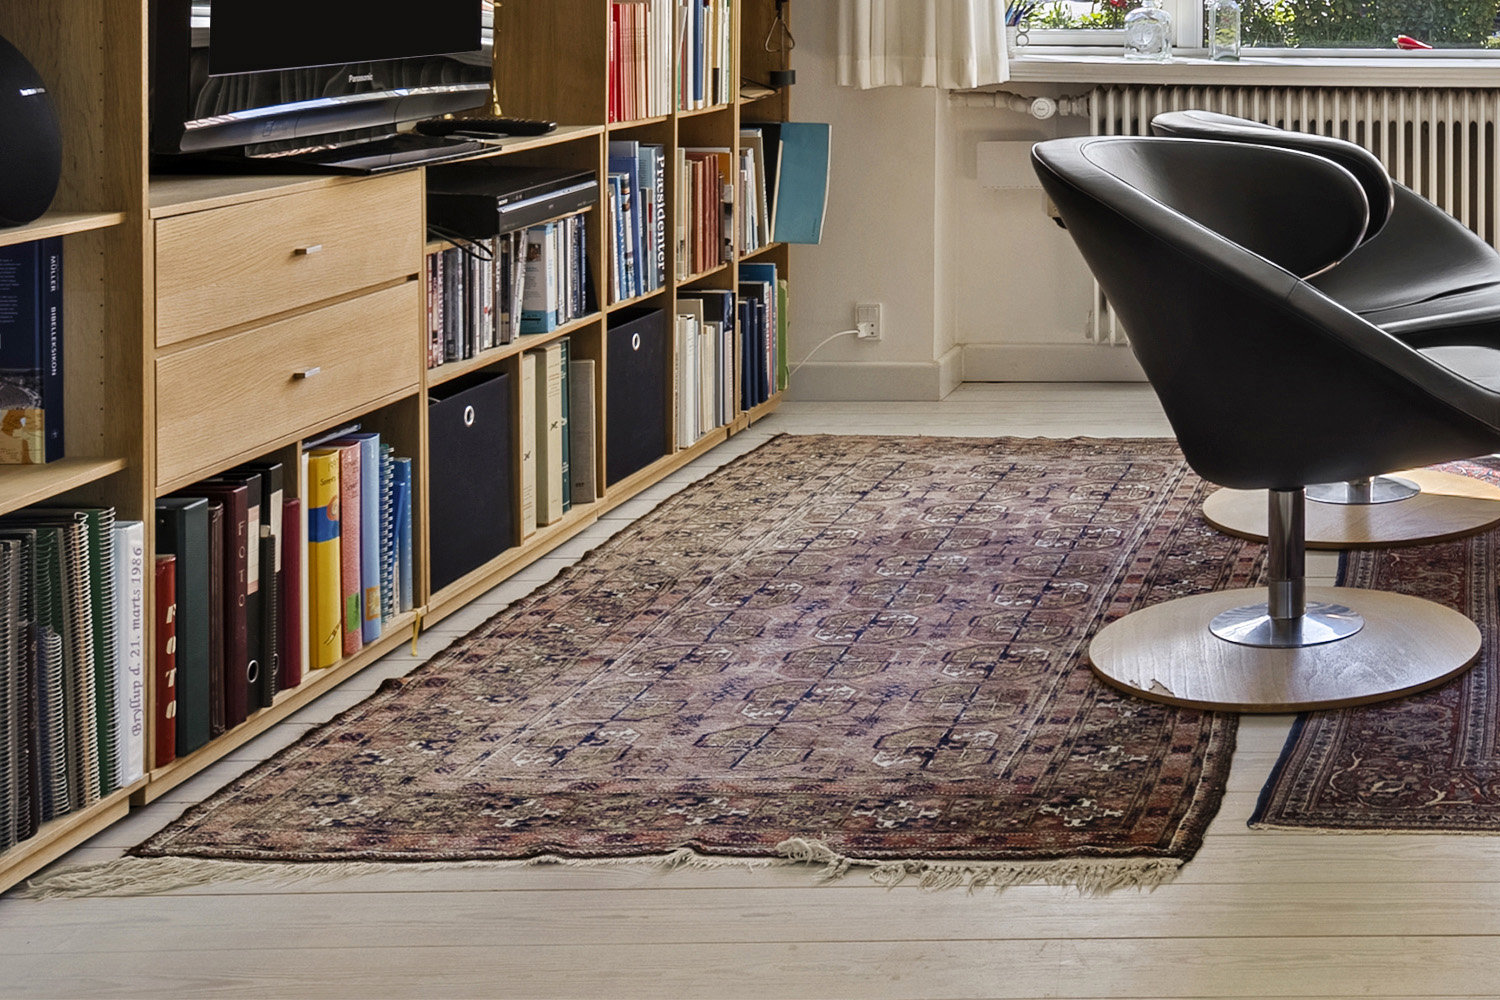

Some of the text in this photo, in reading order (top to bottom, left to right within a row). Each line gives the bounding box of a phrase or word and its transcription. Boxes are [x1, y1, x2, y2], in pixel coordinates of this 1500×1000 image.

[349, 73, 373, 83] Panasonic
[655, 155, 666, 271] Præsidenter
[50, 255, 58, 292] MÜLLER
[131, 546, 142, 584] 1986
[238, 519, 247, 607] FOTO
[132, 588, 142, 631] marts
[131, 635, 141, 659] 21.
[130, 680, 143, 737] Bryllup
